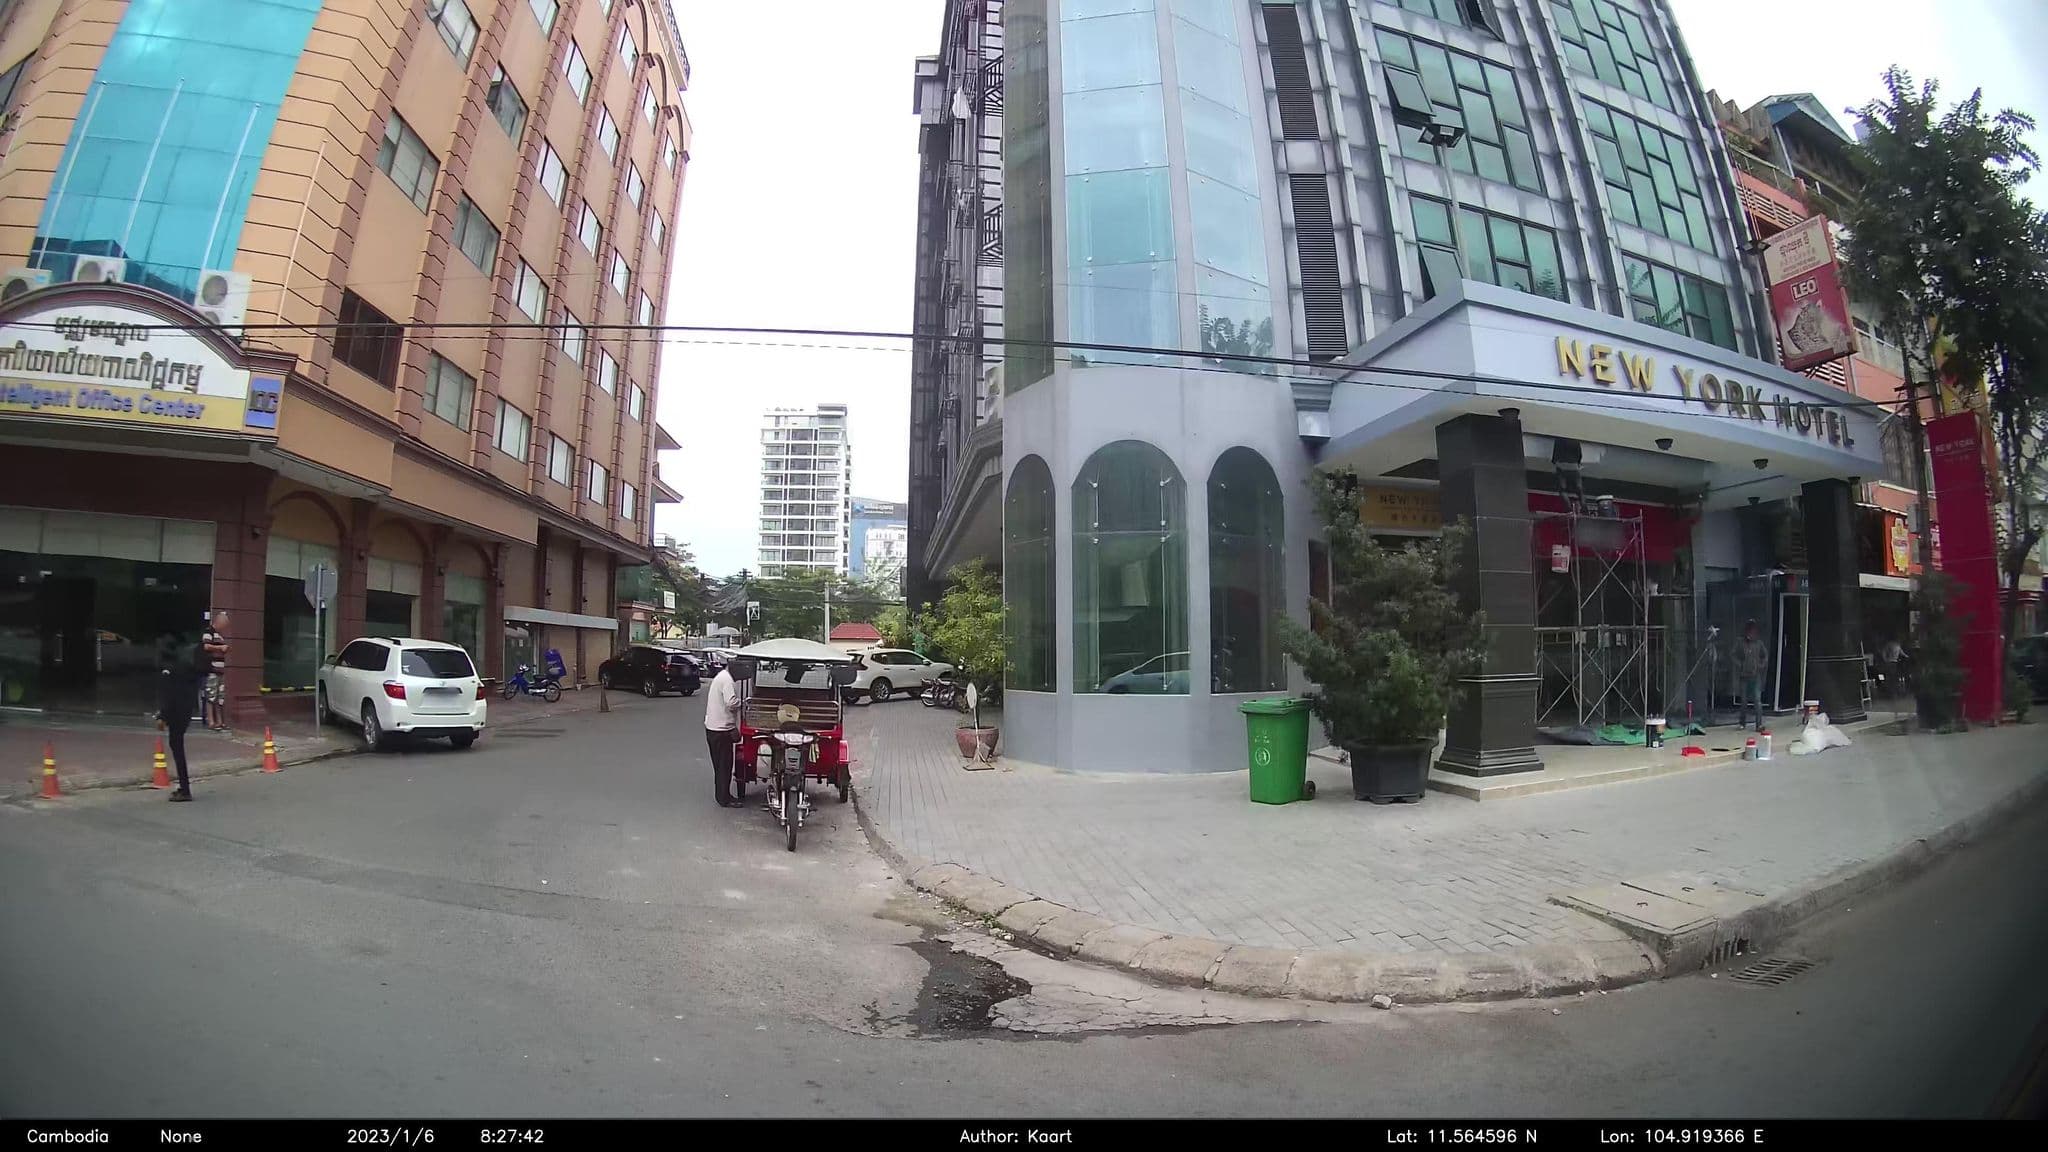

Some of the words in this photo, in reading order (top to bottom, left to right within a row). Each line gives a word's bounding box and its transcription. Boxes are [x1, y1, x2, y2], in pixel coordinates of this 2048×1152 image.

[1793, 279, 1817, 299] LEO
[76, 387, 133, 413] Office
[138, 393, 205, 420] Center
[1555, 335, 1656, 392] NEW
[1672, 363, 1767, 422] YORK
[1773, 392, 1855, 450] HOTEL
[1380, 495, 1407, 505] NEW
